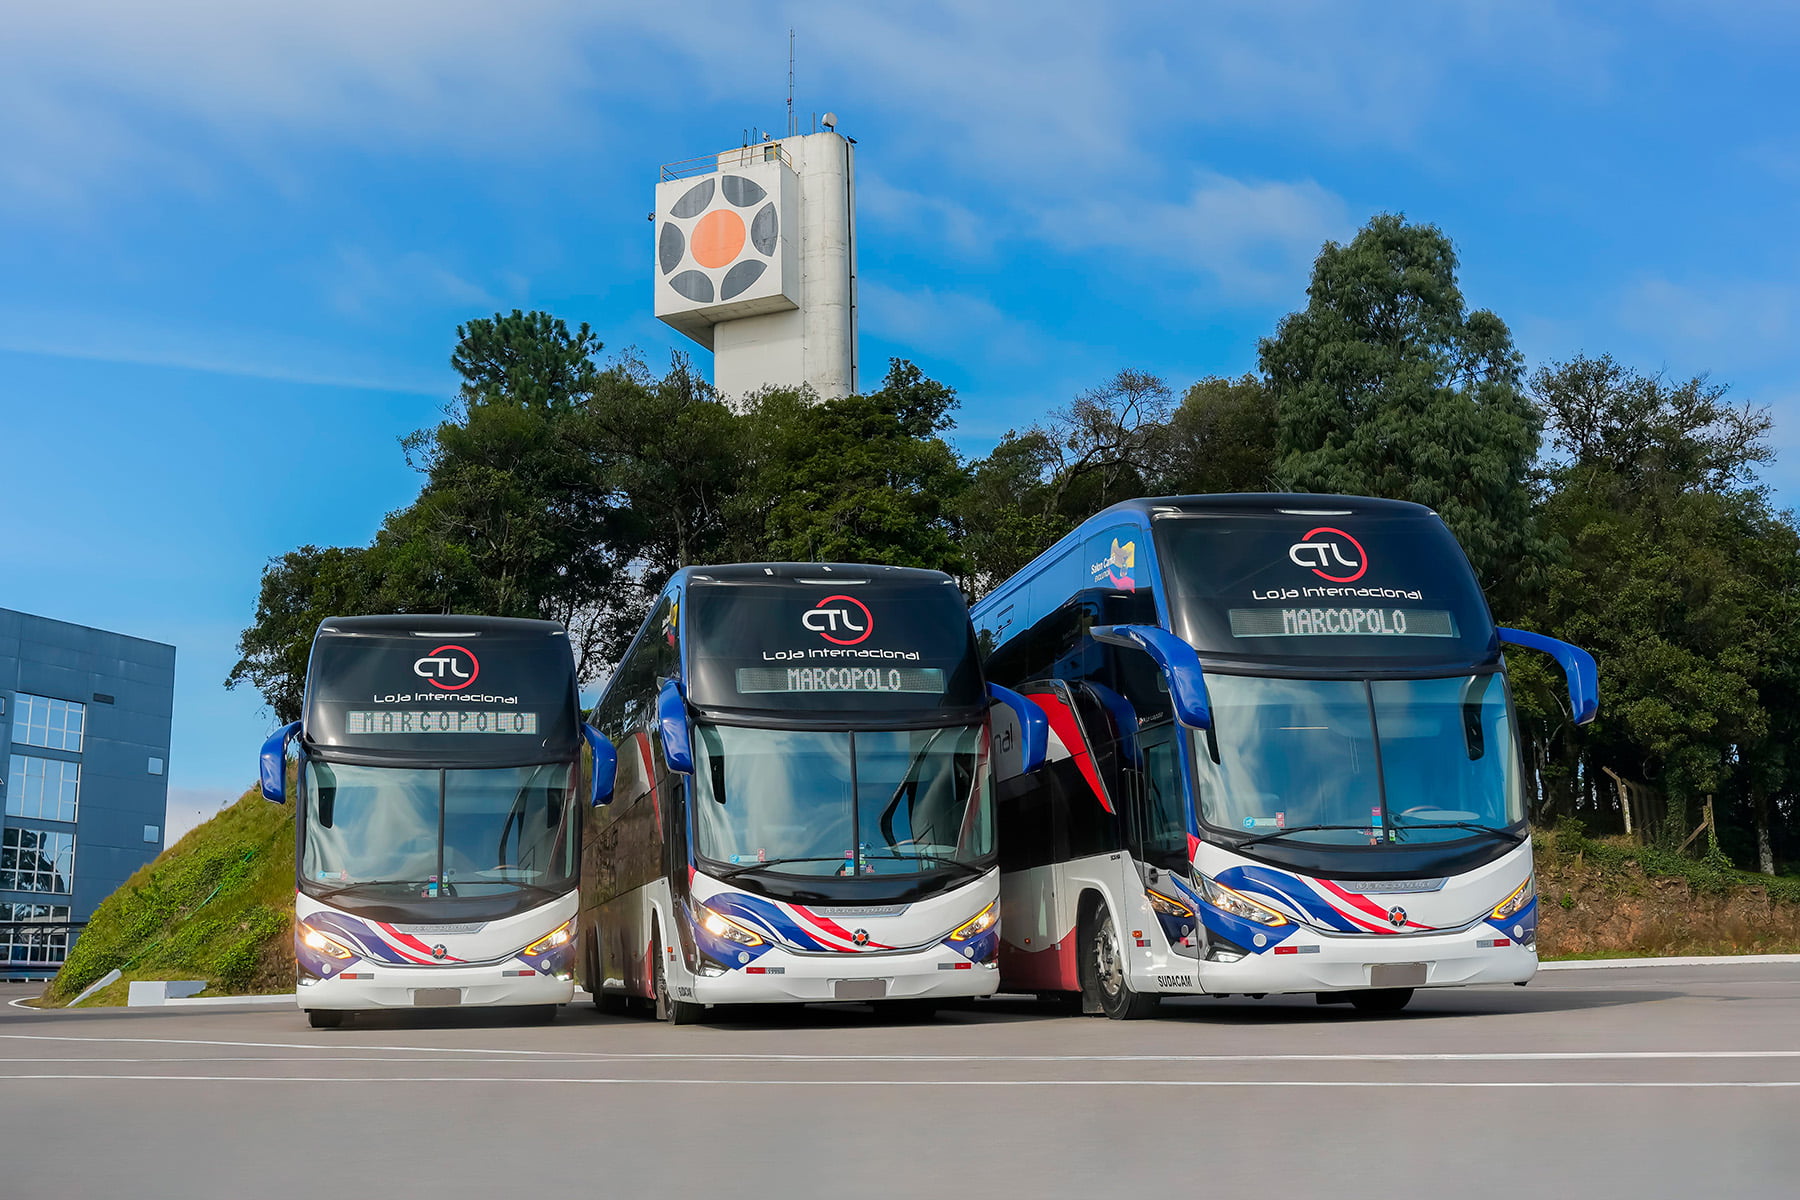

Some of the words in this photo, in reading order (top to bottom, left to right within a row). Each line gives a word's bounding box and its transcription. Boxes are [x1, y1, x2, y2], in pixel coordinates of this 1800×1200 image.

[1288, 542, 1359, 568] CTL
[1252, 588, 1300, 601] Loja
[1302, 586, 1423, 601] Internacional
[802, 608, 864, 632] CTL
[1282, 608, 1407, 635] MARCOPOLO
[762, 650, 805, 661] Loja
[808, 648, 920, 661] Internacional
[413, 657, 469, 678] CTL
[787, 668, 901, 691] MARCOPOLO
[373, 694, 412, 704] Loja
[414, 692, 518, 705] Internacional
[362, 711, 525, 733] MARCOPOLO
[1157, 975, 1193, 988] SUDACAM
